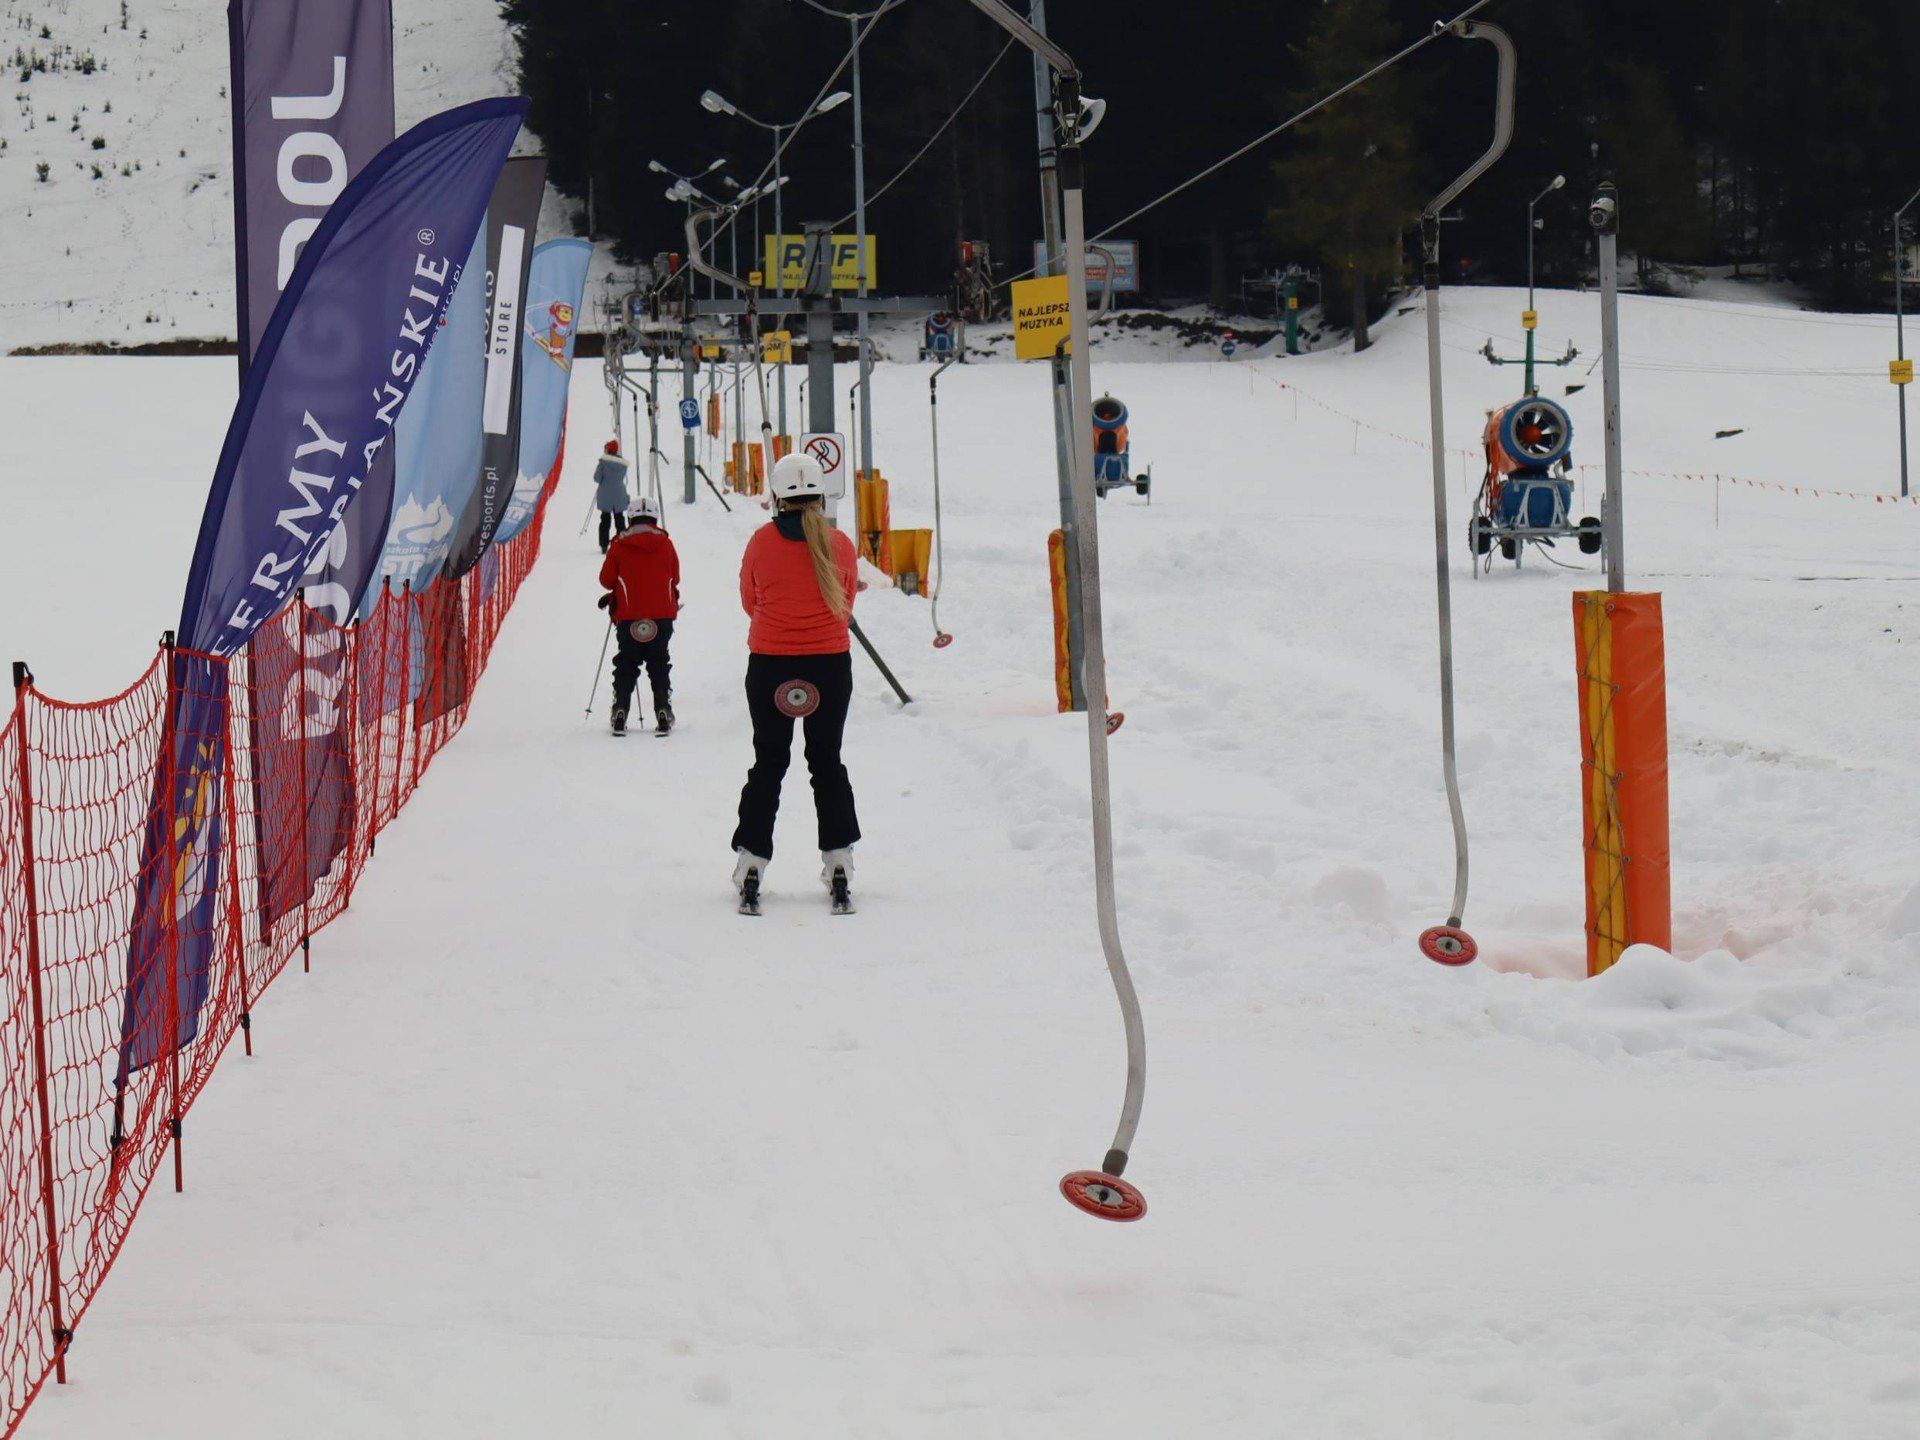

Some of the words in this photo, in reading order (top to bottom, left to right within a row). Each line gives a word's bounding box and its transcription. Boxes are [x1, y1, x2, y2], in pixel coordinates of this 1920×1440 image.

[782, 243, 858, 268] RF
[1018, 302, 1070, 317] NAJLEPSZ
[496, 301, 512, 355] STORE
[1019, 316, 1064, 331] MUZYKA
